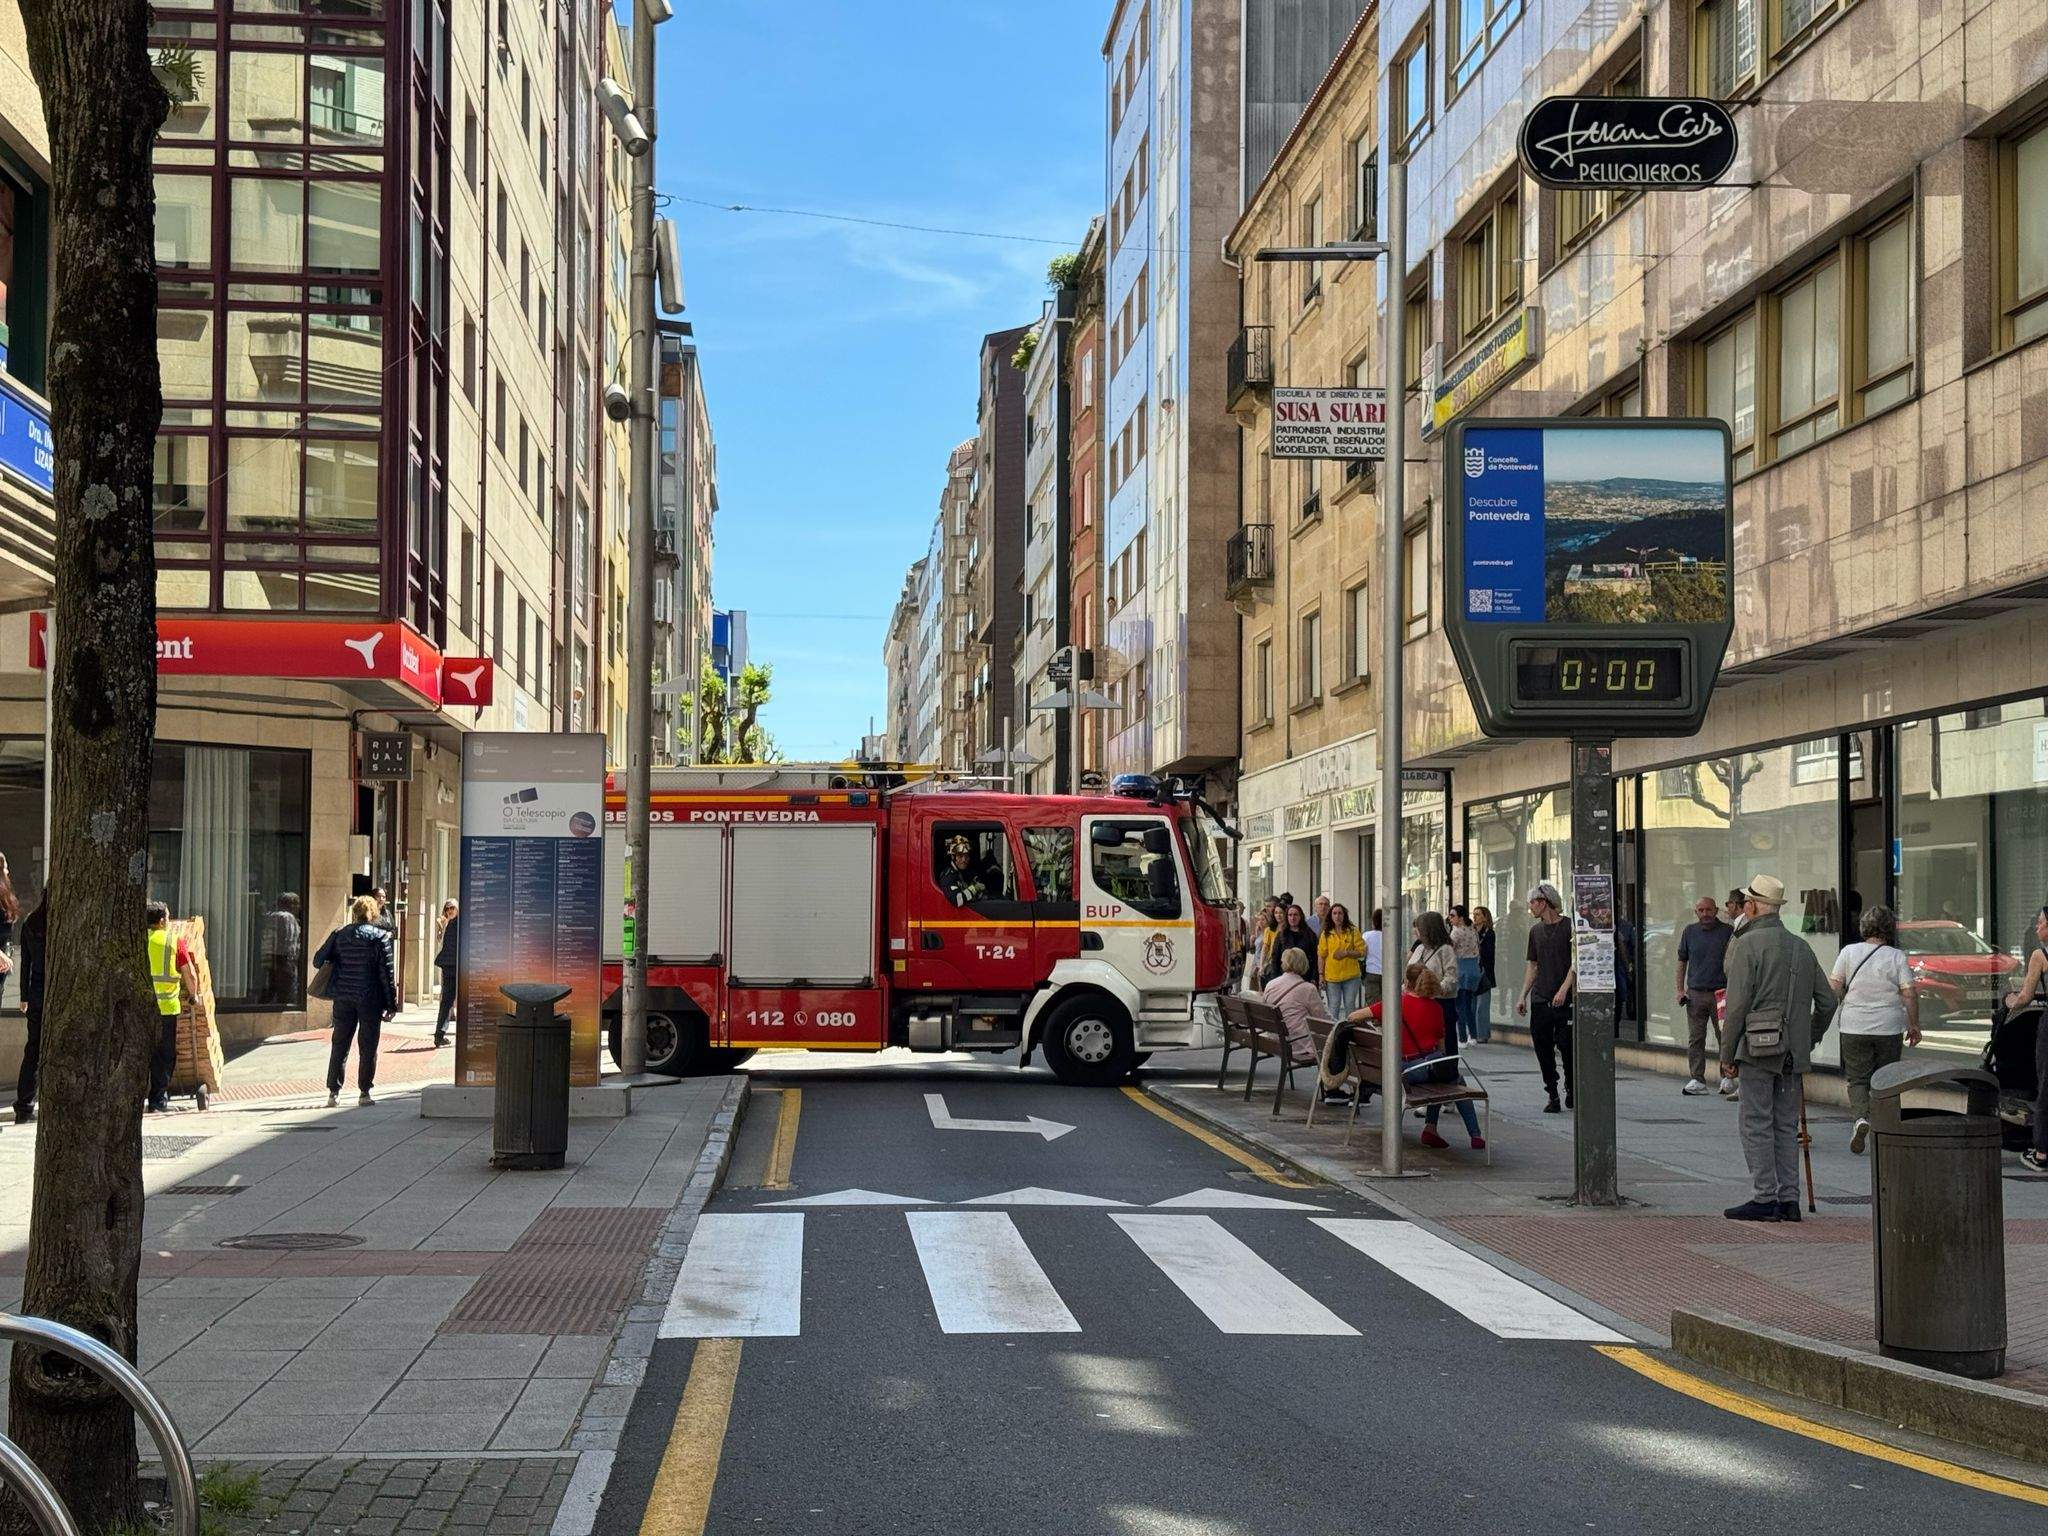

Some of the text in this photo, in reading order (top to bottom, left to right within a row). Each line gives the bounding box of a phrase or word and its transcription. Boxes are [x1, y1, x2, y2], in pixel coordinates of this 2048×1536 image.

[1579, 162, 1702, 182] PELUQUEROS
[1276, 390, 1311, 398] ESCUELA
[1316, 391, 1327, 399] DE
[1330, 391, 1359, 399] DISEÑO
[1361, 392, 1373, 400] DE
[1276, 402, 1321, 422] SUSA
[1276, 425, 1386, 435] PATRONISTA INDUSTRIA
[1333, 436, 1386, 445] DISEÑADO
[34, 446, 54, 475] LIZAR
[1469, 497, 1518, 507] Descubre
[1469, 511, 1530, 521] Pontevedra
[155, 636, 193, 659] ent
[1561, 660, 1656, 691] 0:00
[516, 806, 566, 820] Telescopio
[690, 810, 820, 822] PONTEVEDRA
[1086, 905, 1121, 918] BUP
[976, 945, 1015, 960] T-24
[747, 1011, 856, 1026] 112 080
